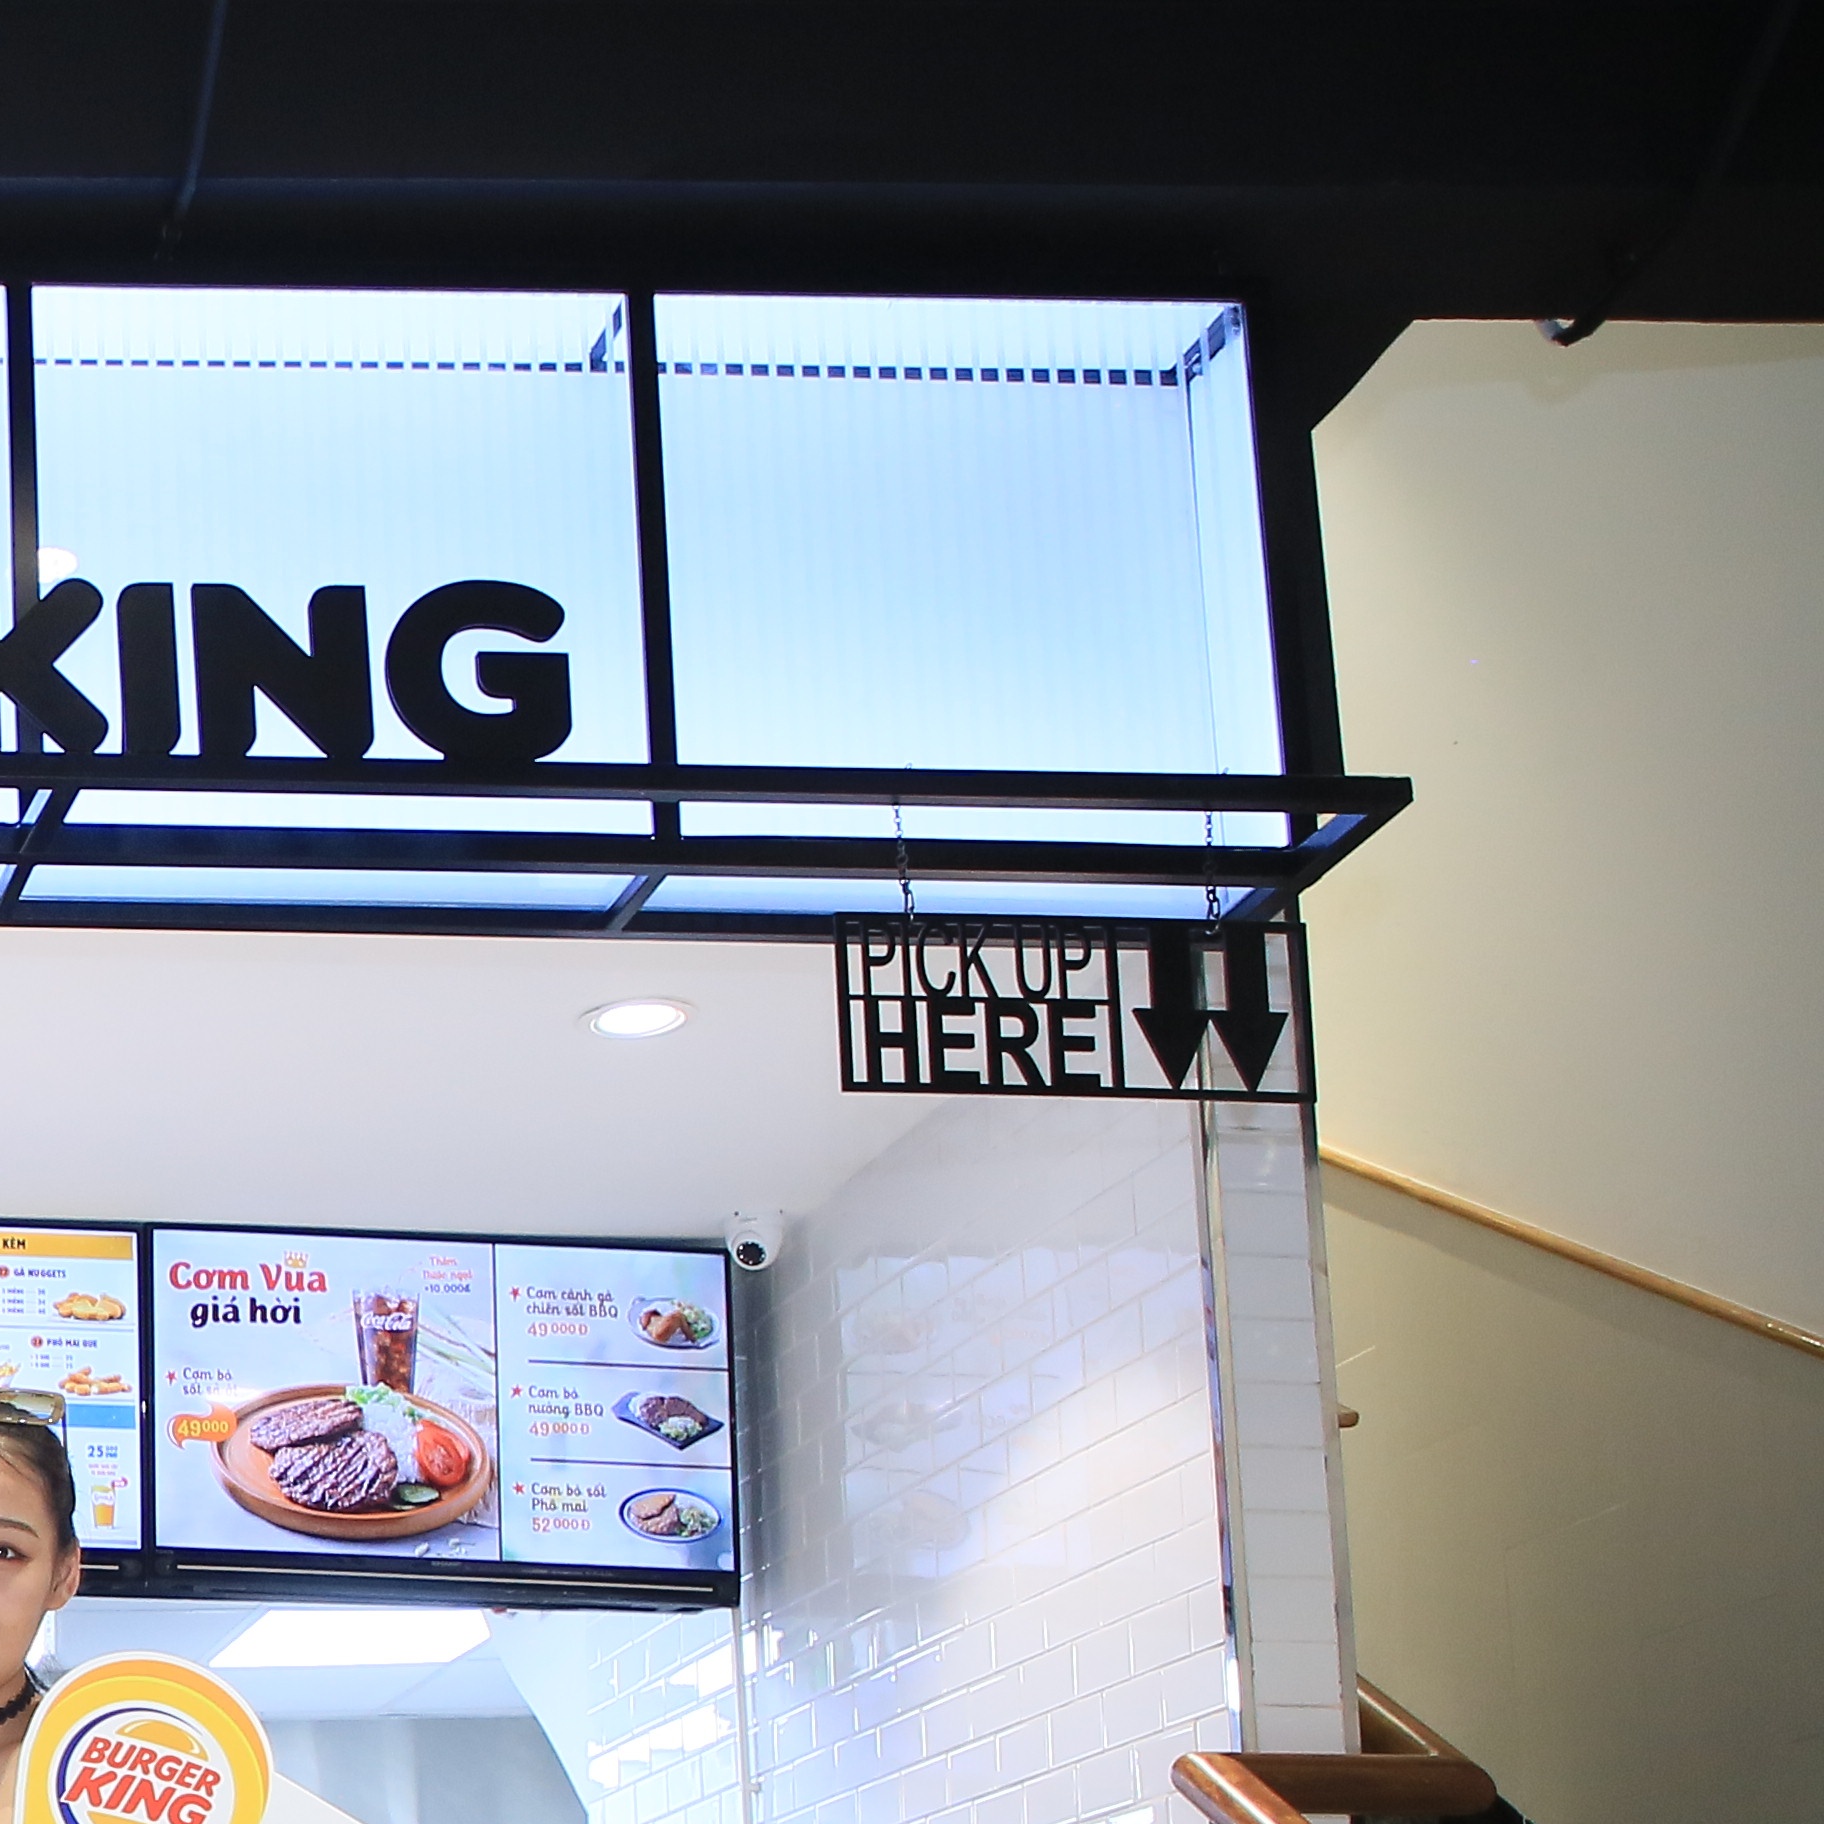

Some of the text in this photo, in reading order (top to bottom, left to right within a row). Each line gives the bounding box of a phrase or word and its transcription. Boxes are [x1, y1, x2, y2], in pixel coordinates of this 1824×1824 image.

[862, 924, 1095, 1000] PICK UP
[866, 1000, 1103, 1089] HERE
[2, 1236, 26, 1250] KÈM
[168, 1261, 328, 1293] Cơm Vua
[190, 1295, 302, 1328] giá hời
[588, 1304, 619, 1319] BBQ
[574, 1404, 604, 1418] BBQ
[87, 1445, 104, 1458] 25
[80, 1736, 221, 1796] BURGER
